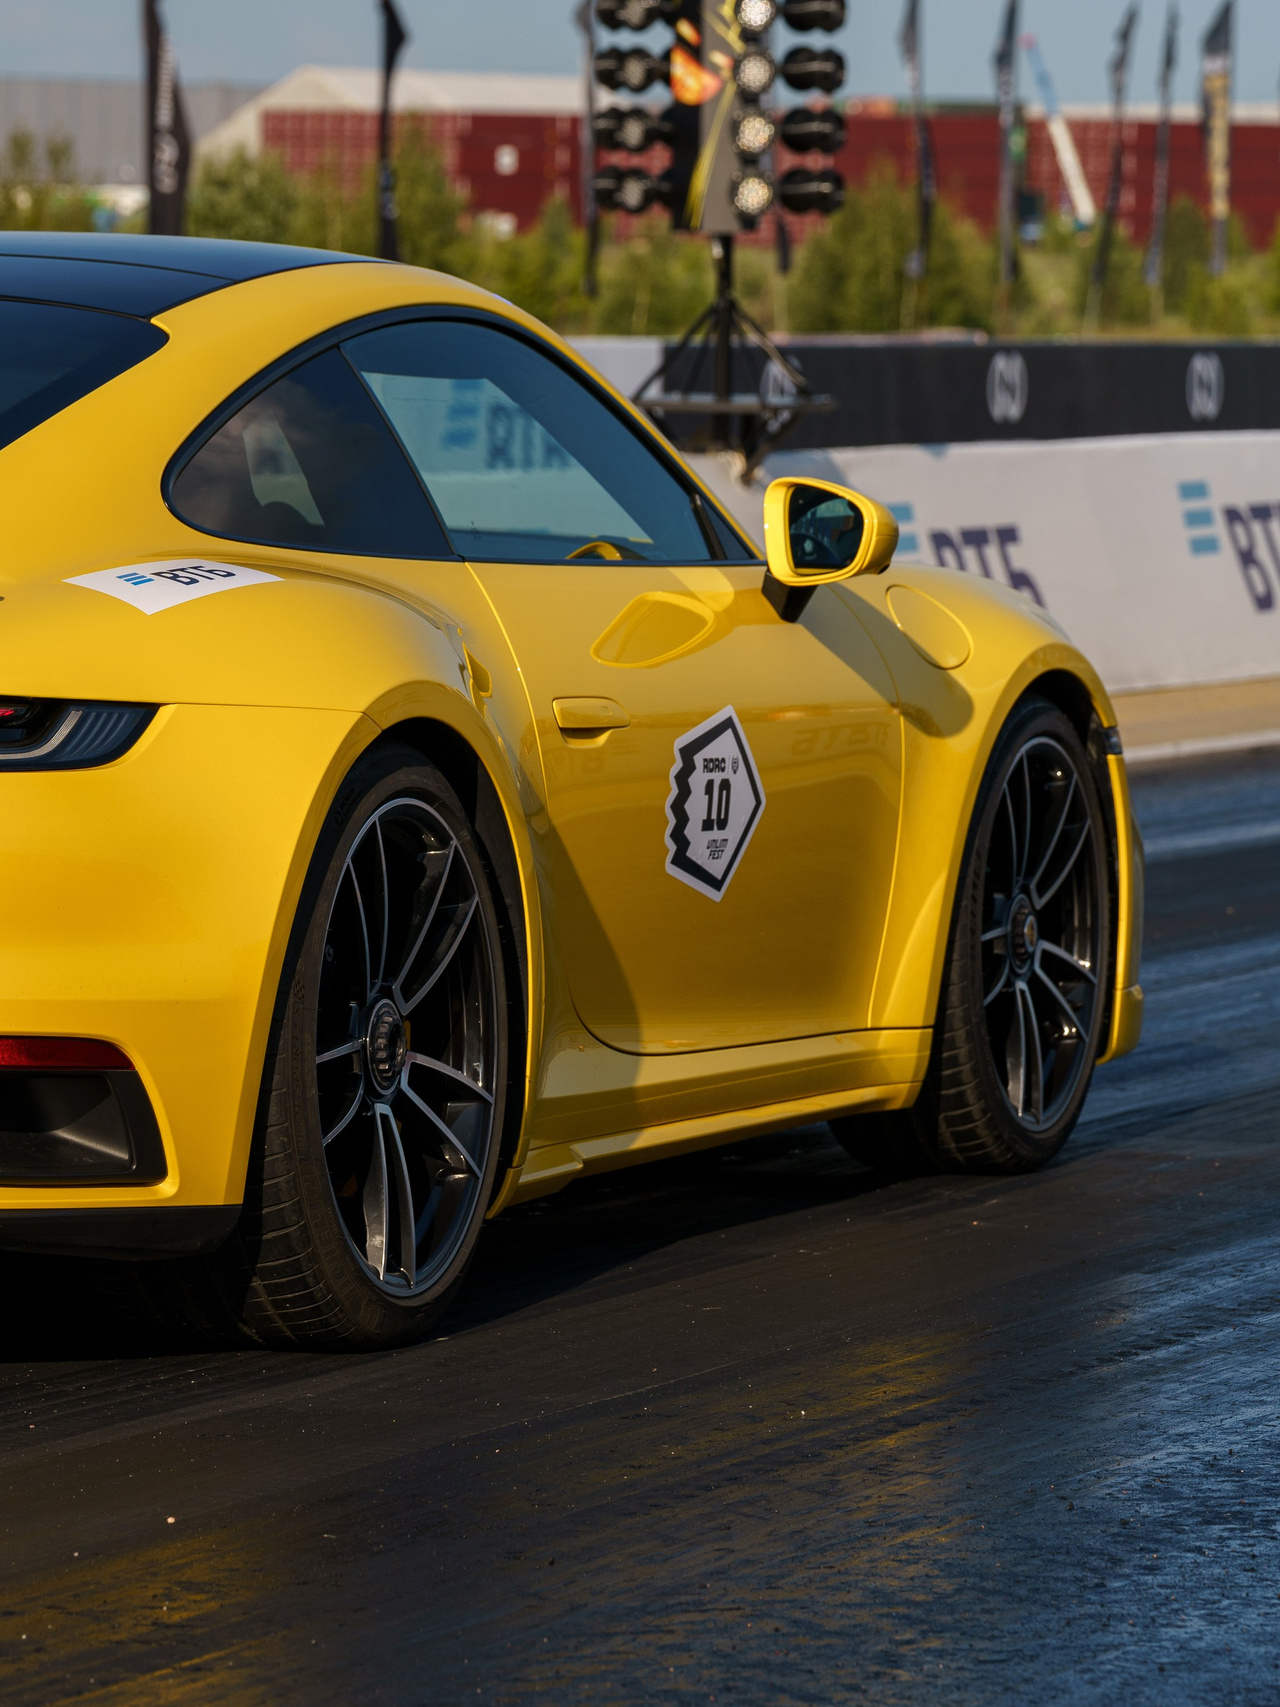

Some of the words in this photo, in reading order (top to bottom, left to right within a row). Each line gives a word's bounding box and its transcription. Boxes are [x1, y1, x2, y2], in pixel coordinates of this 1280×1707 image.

[150, 565, 236, 586] ВТБ
[702, 757, 727, 774] RDRC
[701, 778, 731, 832] 10
[708, 849, 724, 860] FEST
[291, 1031, 302, 1095] SPORT
[293, 1101, 308, 1150] PILOT
[301, 1174, 360, 1311] MICHELIN
